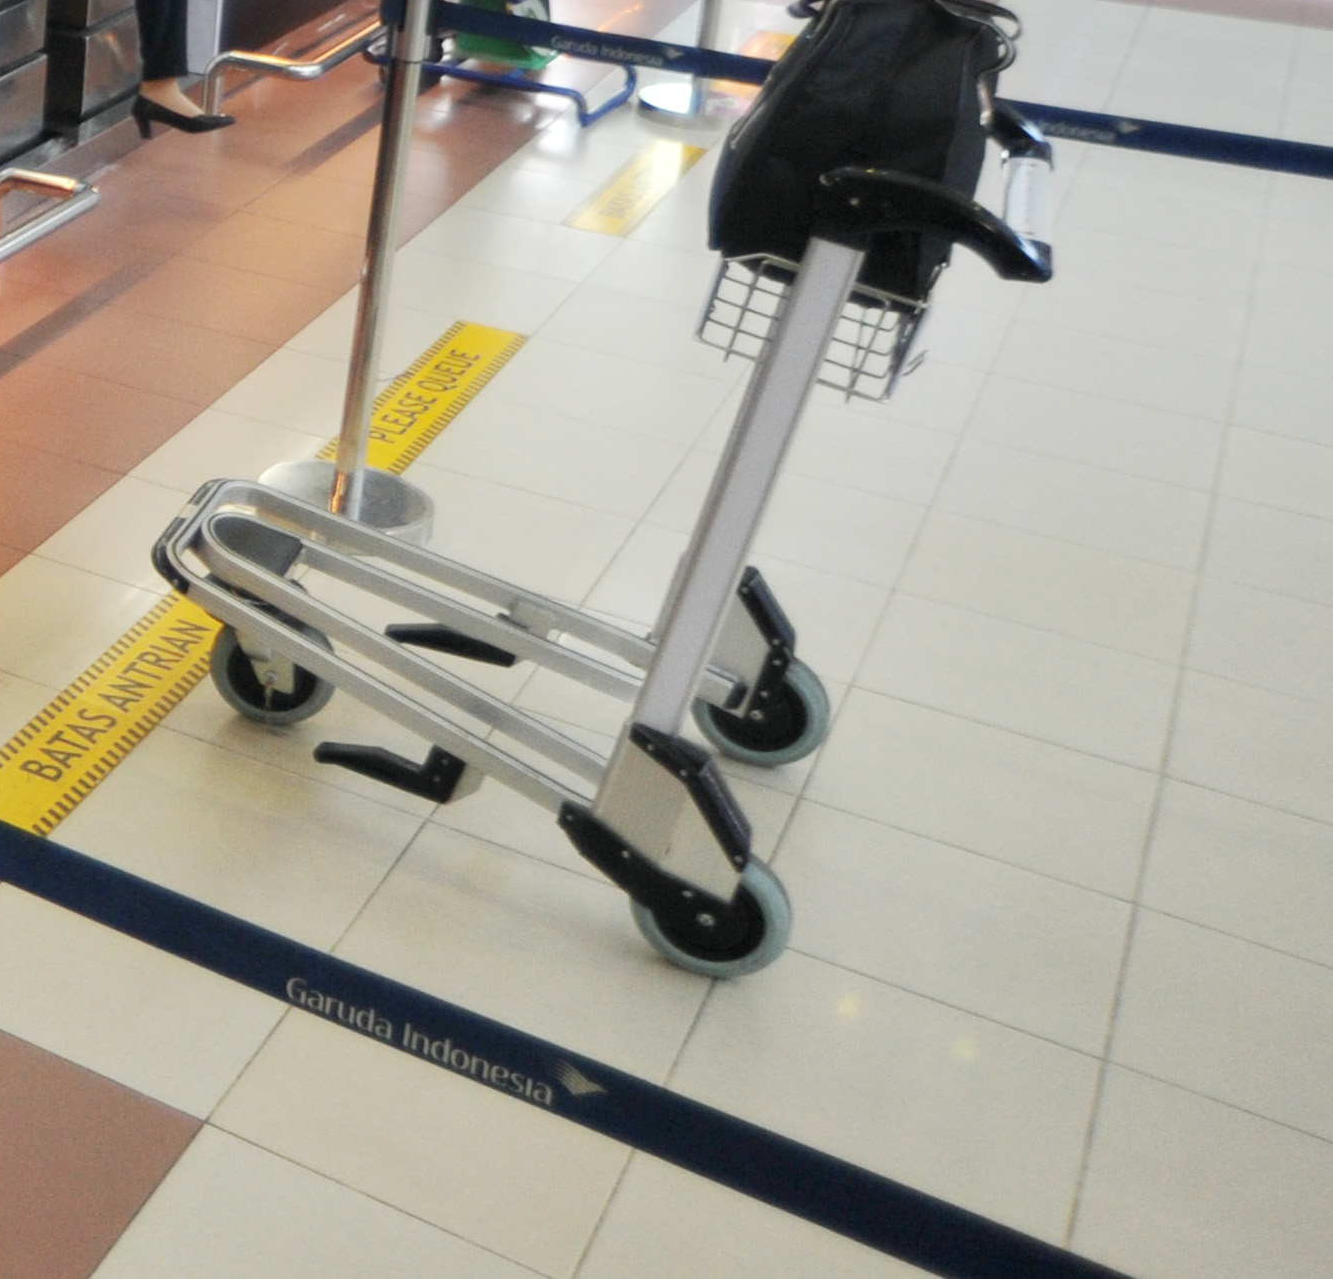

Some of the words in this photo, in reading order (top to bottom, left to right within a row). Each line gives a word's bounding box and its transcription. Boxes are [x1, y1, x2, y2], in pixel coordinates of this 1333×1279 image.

[550, 34, 599, 56] Garuda
[600, 44, 664, 67] Indonesia
[369, 391, 438, 445] PLEASE
[417, 348, 482, 393] QUEUE
[18, 707, 118, 783] BATAS
[97, 618, 213, 714] ANTRIAN
[285, 976, 393, 1041] Garuda
[402, 1021, 554, 1107] Indonesia
